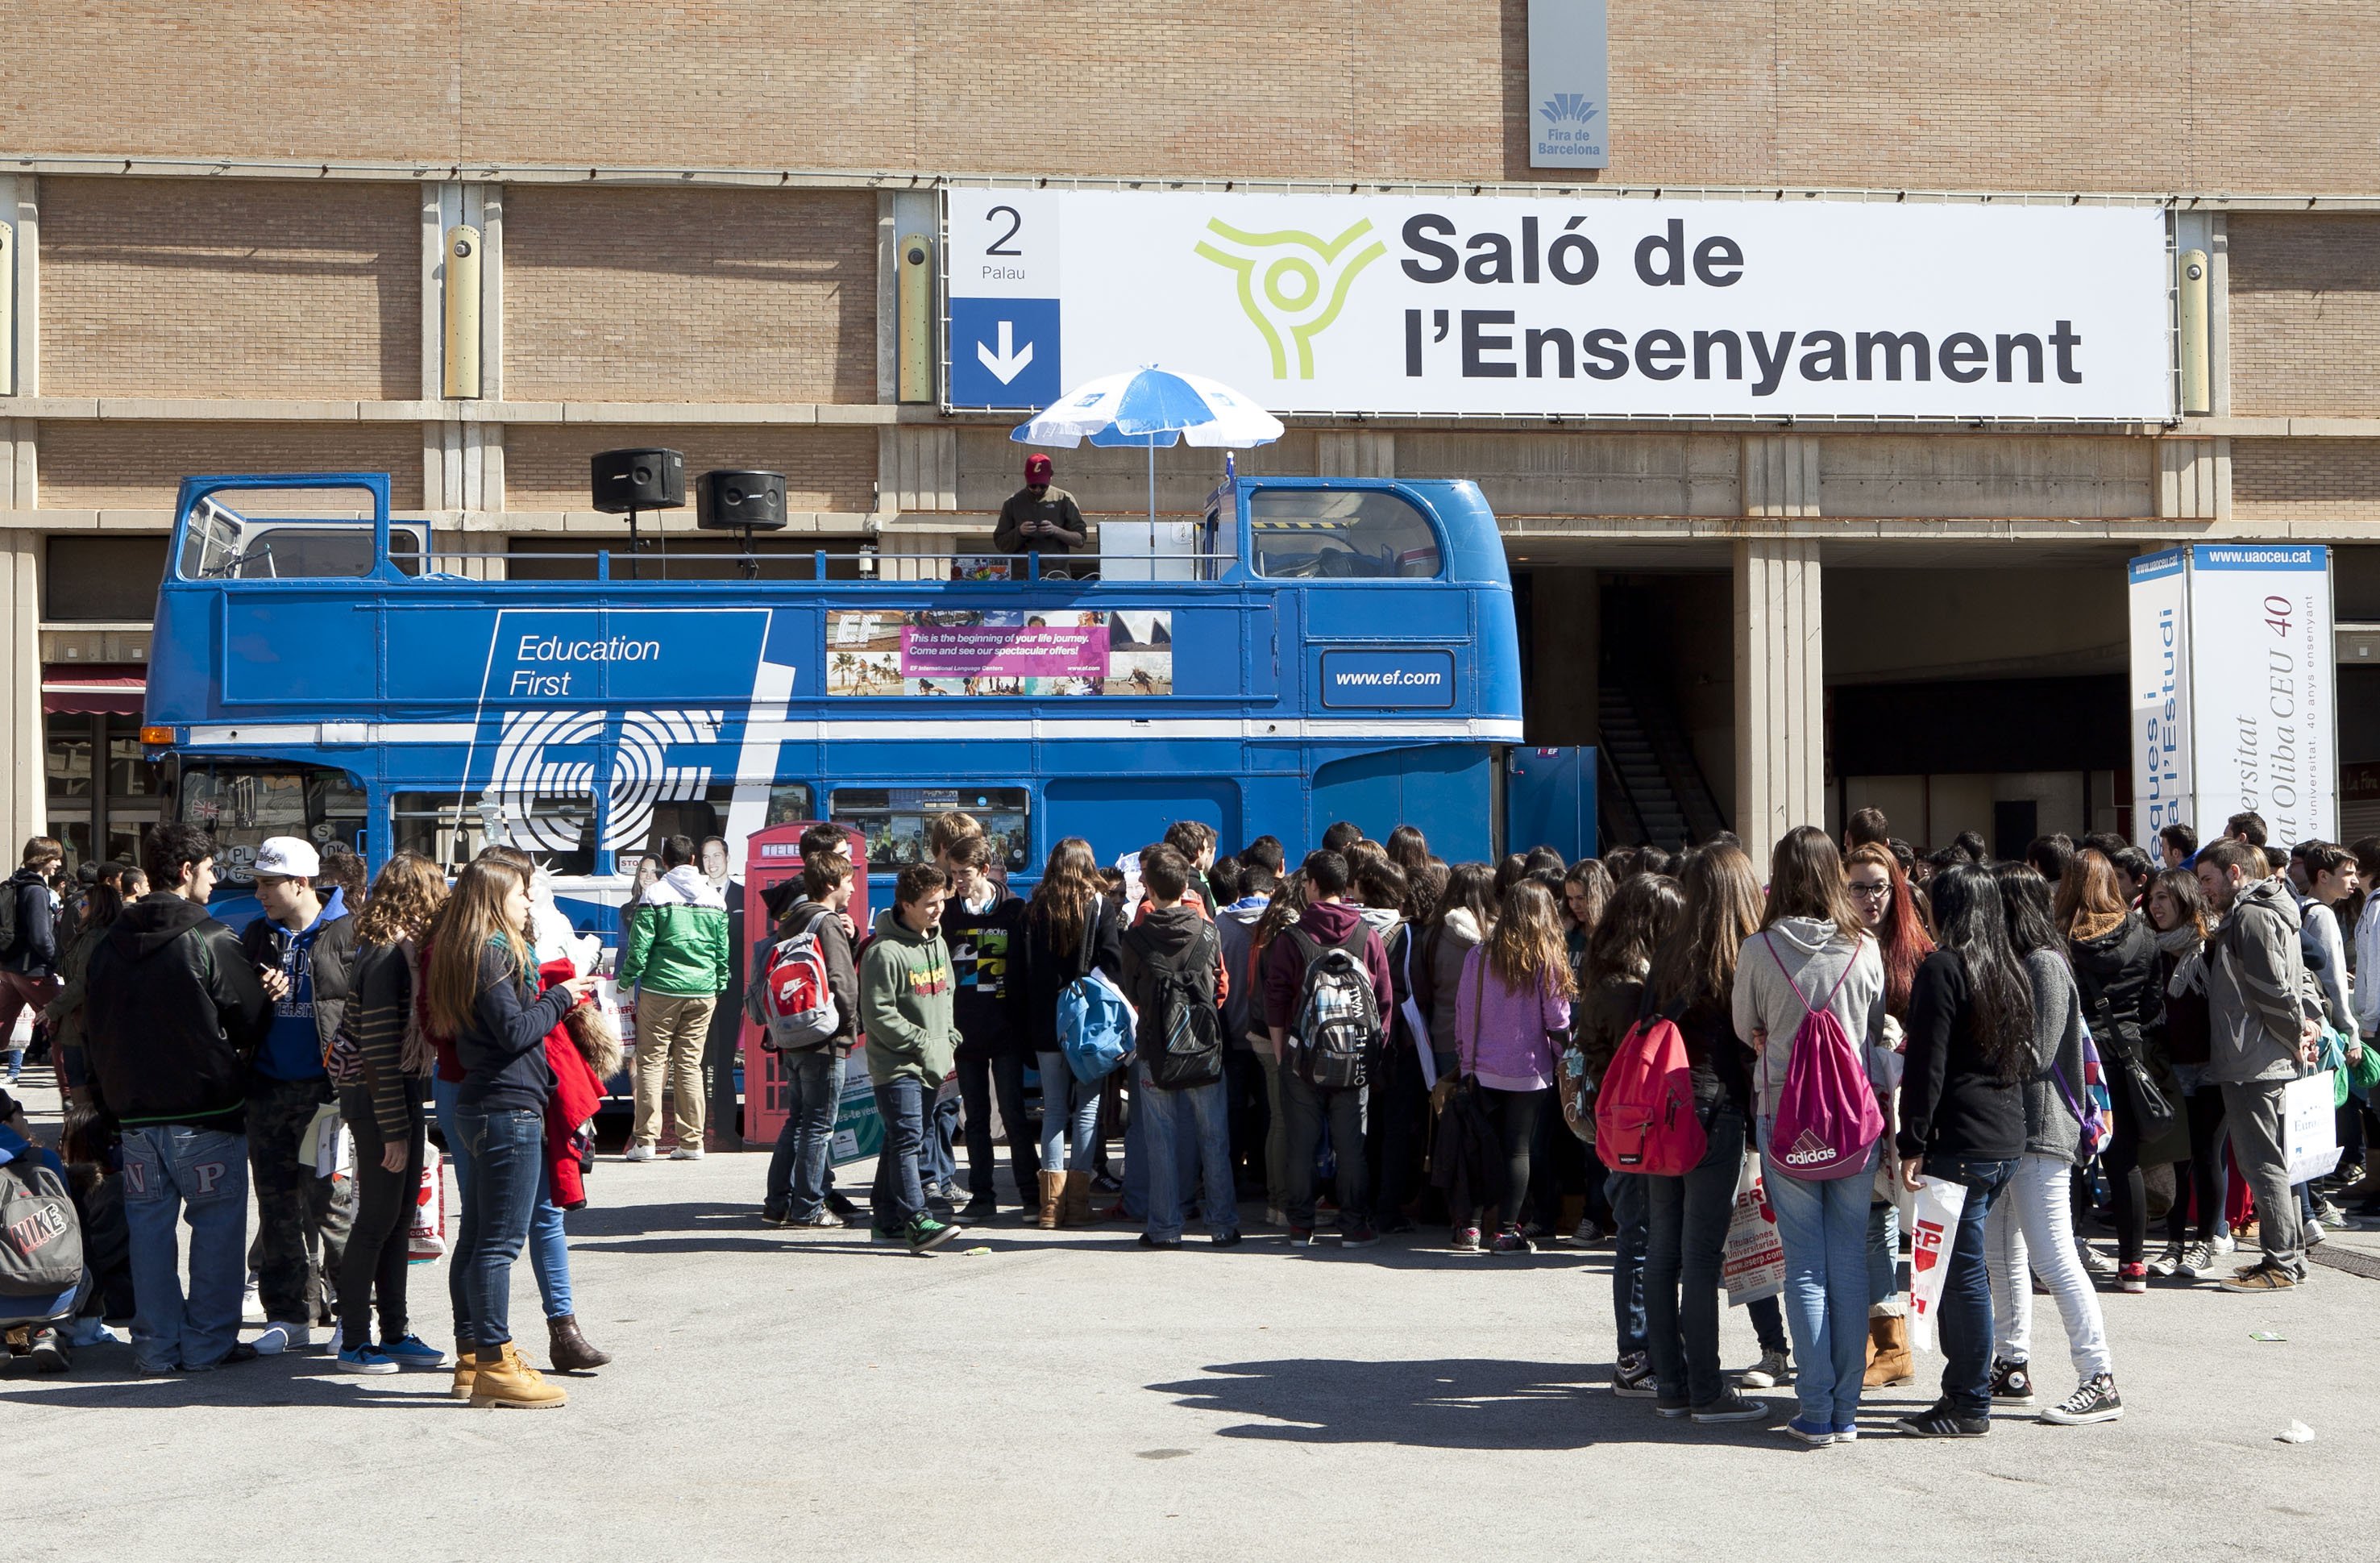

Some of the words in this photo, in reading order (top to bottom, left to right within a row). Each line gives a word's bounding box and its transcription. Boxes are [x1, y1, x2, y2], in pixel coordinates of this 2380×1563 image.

[1547, 129, 1572, 141] Fira
[1575, 129, 1590, 141] de
[1538, 143, 1601, 156] Barcelona
[986, 206, 1022, 256] 2
[1400, 213, 1600, 287] Saló
[1634, 218, 1745, 288] de
[982, 266, 1025, 280] Palau
[2135, 552, 2179, 575] www.uaoceu.cat
[2209, 549, 2312, 563] www.uaoceu.cat
[2263, 595, 2293, 638] 40
[909, 633, 929, 642] This
[930, 633, 939, 642] is
[941, 633, 956, 642] the
[957, 633, 1003, 645] beginning
[1004, 634, 1016, 643] of
[1015, 635, 1036, 646] your
[1037, 634, 1053, 643] life
[1052, 634, 1090, 646] journey.
[2304, 595, 2316, 668] ensenyant
[517, 635, 661, 662] Education
[909, 646, 937, 655] Come
[938, 646, 957, 655] and
[957, 647, 975, 655] see
[994, 646, 1049, 658] spectacular
[1049, 646, 1079, 655] offers!
[953, 665, 981, 673] Language
[1336, 670, 1441, 684] www.ef.com
[509, 670, 571, 696] First
[2269, 647, 2295, 718] CEU
[2306, 673, 2318, 706] anys
[2307, 713, 2316, 729] 40
[2233, 714, 2259, 813] ersitat
[2270, 725, 2296, 809] Oliba
[2147, 717, 2164, 870] eques
[318, 825, 328, 837] S
[2274, 813, 2297, 853] at
[233, 849, 252, 862] PL
[767, 846, 800, 855] TELE
[621, 859, 639, 867] STO
[783, 977, 802, 994] NIKE
[1348, 985, 1364, 1018] WALL
[1785, 1147, 1837, 1165] adidas
[126, 1163, 145, 1193] N
[193, 1162, 226, 1194] P
[1738, 1188, 1765, 1209] ER
[10, 1203, 67, 1255] NIKE
[1728, 1229, 1774, 1249] Titulaciones
[1911, 1227, 1942, 1248] RP
[1726, 1237, 1779, 1259] Universitarias
[1726, 1249, 1784, 1273] www.eserp.com
